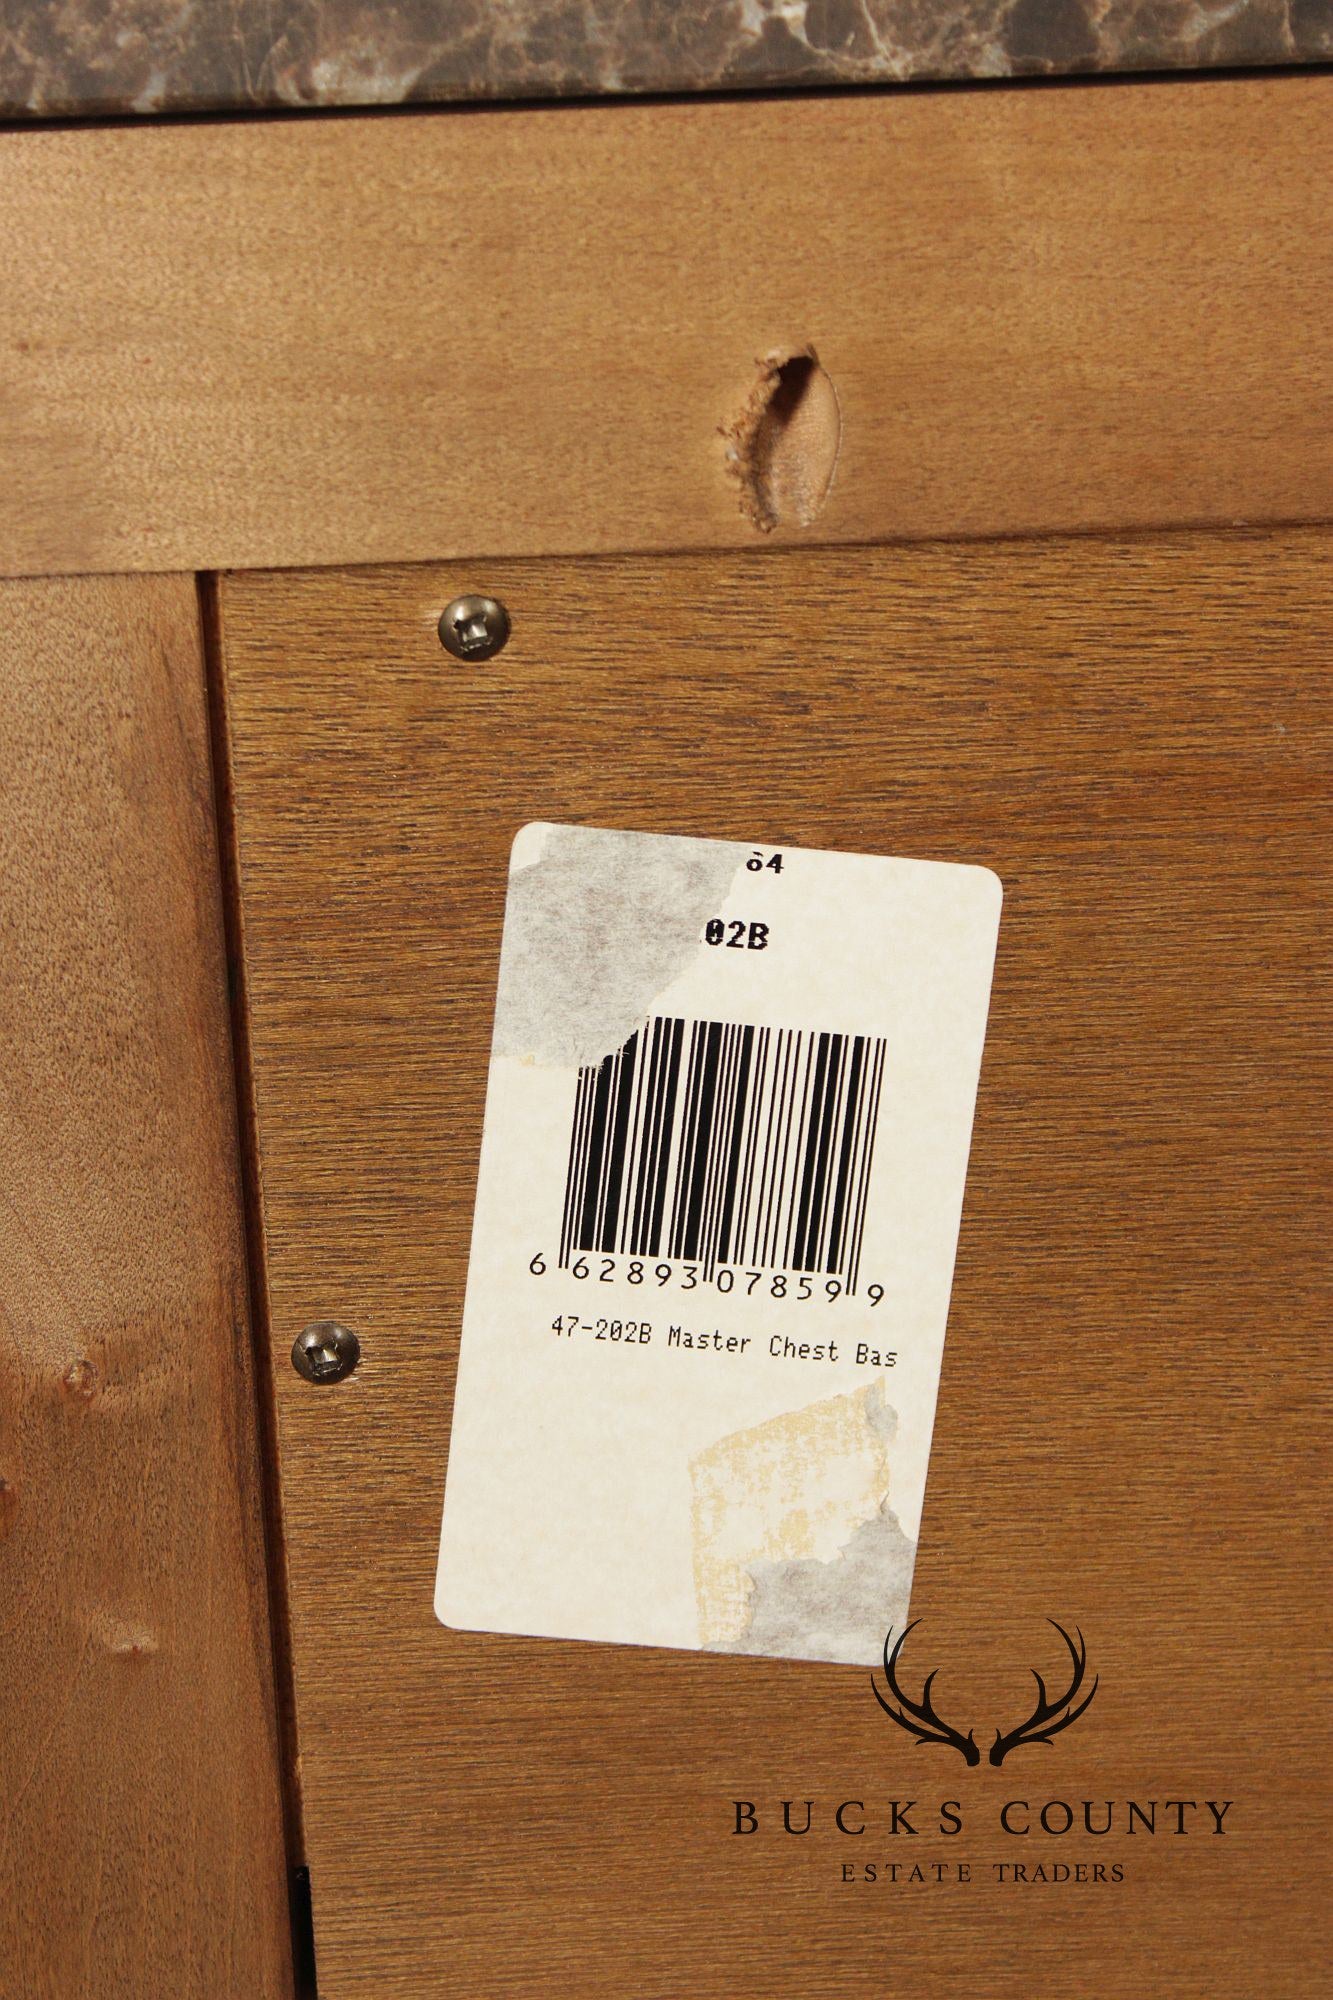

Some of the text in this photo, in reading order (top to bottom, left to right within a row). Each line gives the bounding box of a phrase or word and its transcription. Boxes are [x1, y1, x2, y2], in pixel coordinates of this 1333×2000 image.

[529, 1252, 885, 1307] 6 62893 07859 9
[551, 1315, 898, 1368] 47-202B Master Chest Bas
